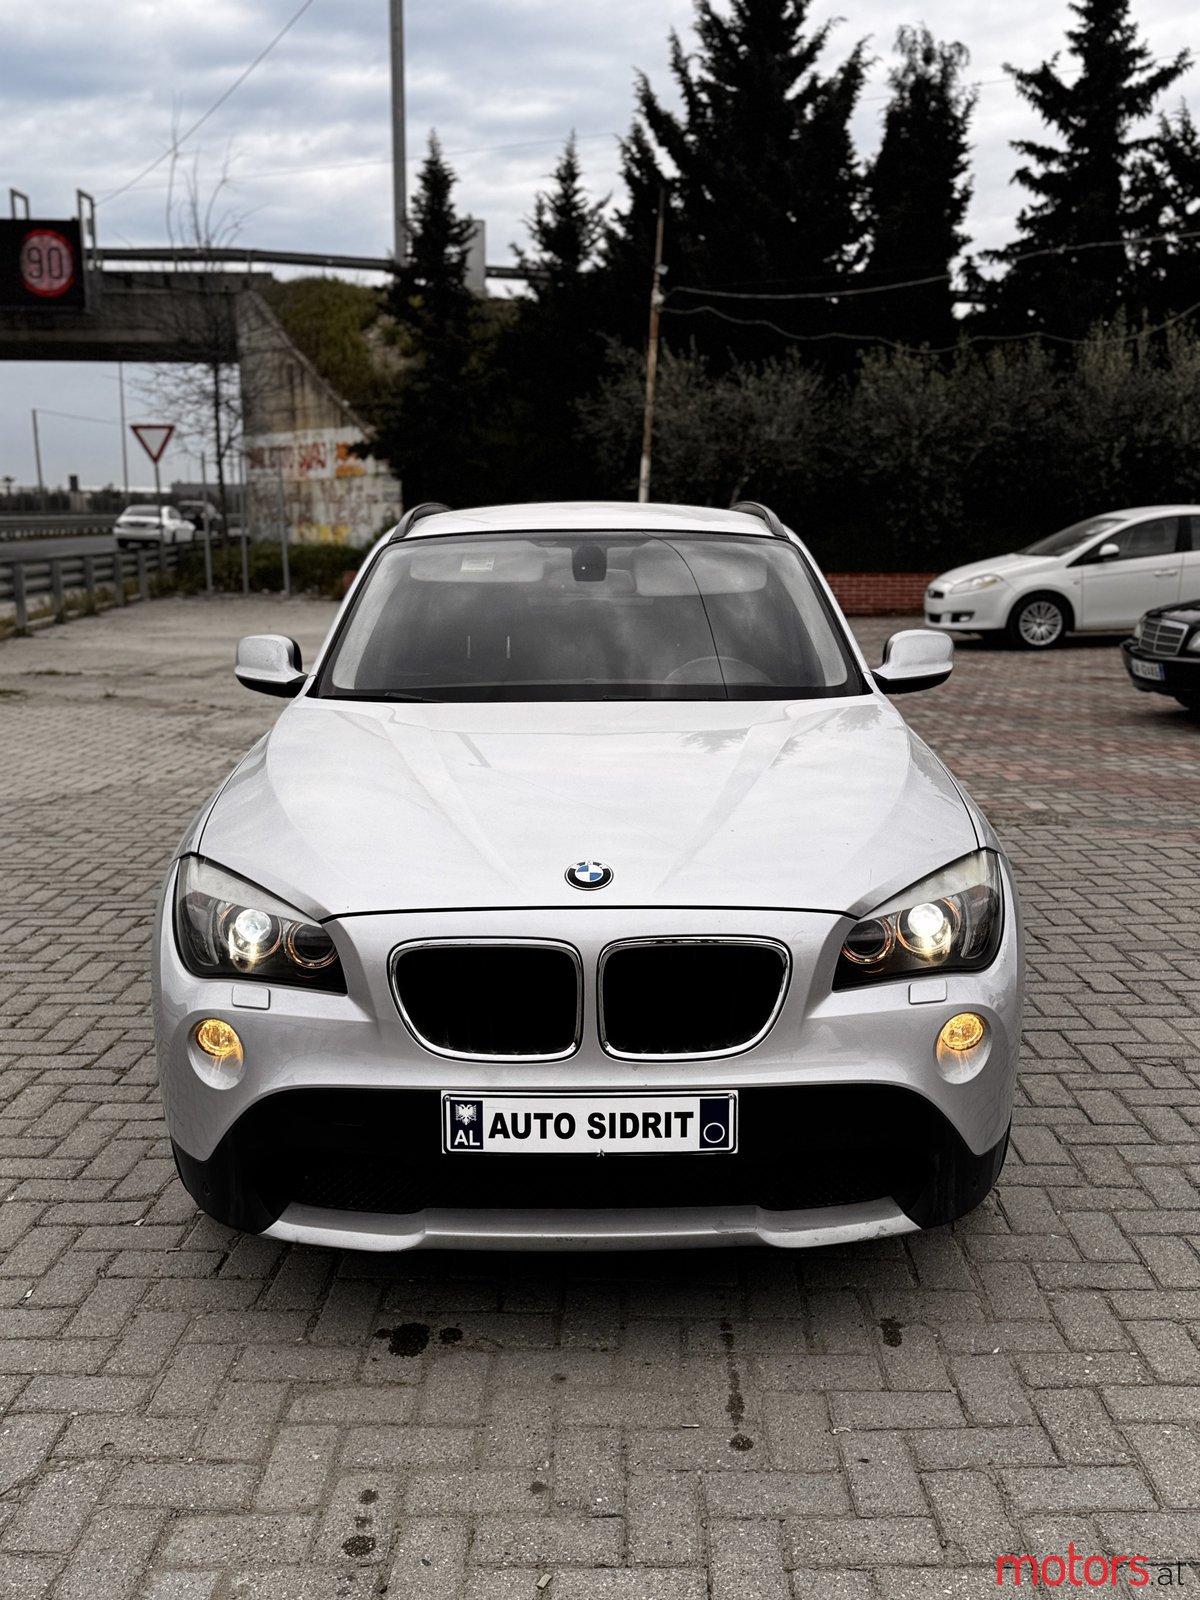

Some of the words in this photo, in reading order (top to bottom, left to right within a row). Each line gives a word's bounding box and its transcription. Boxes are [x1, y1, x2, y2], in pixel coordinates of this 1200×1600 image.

[28, 247, 62, 279] 90
[454, 1130, 480, 1146] AL
[488, 1112, 576, 1139] AUTO
[587, 1111, 694, 1139] SIDRIT
